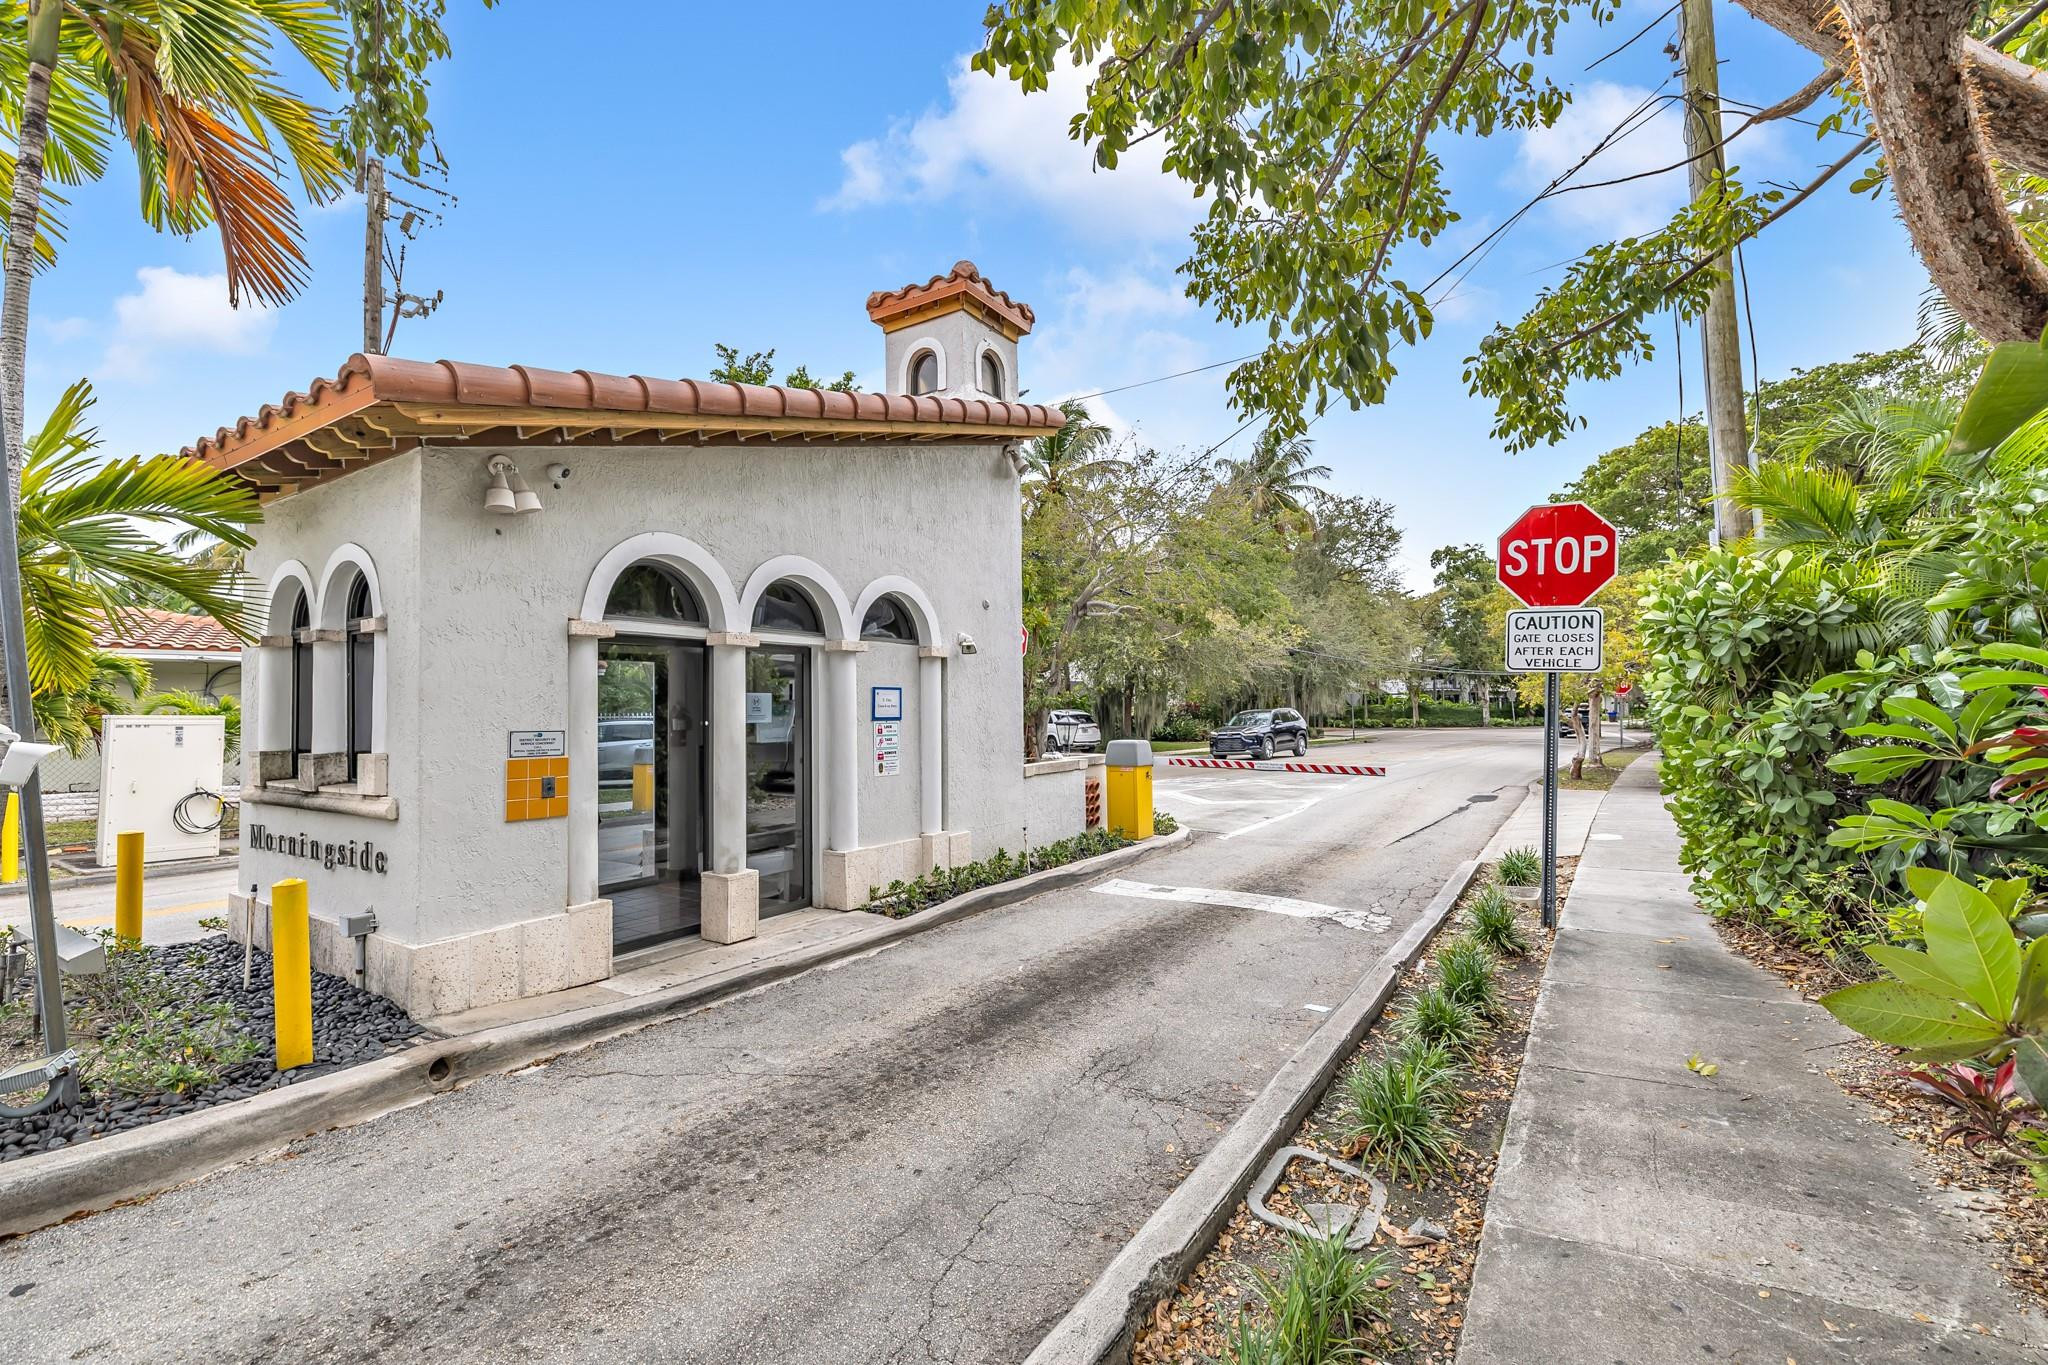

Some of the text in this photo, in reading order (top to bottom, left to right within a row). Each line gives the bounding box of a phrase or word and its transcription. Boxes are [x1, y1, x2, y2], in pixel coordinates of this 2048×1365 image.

[1505, 534, 1609, 577] STOP
[1515, 615, 1594, 630] CAUTION
[1514, 633, 1594, 643] GATE CLOSES
[1514, 646, 1594, 656] AFTER EACH
[1525, 658, 1582, 668] VEHICLE
[249, 824, 388, 874] Morningside
